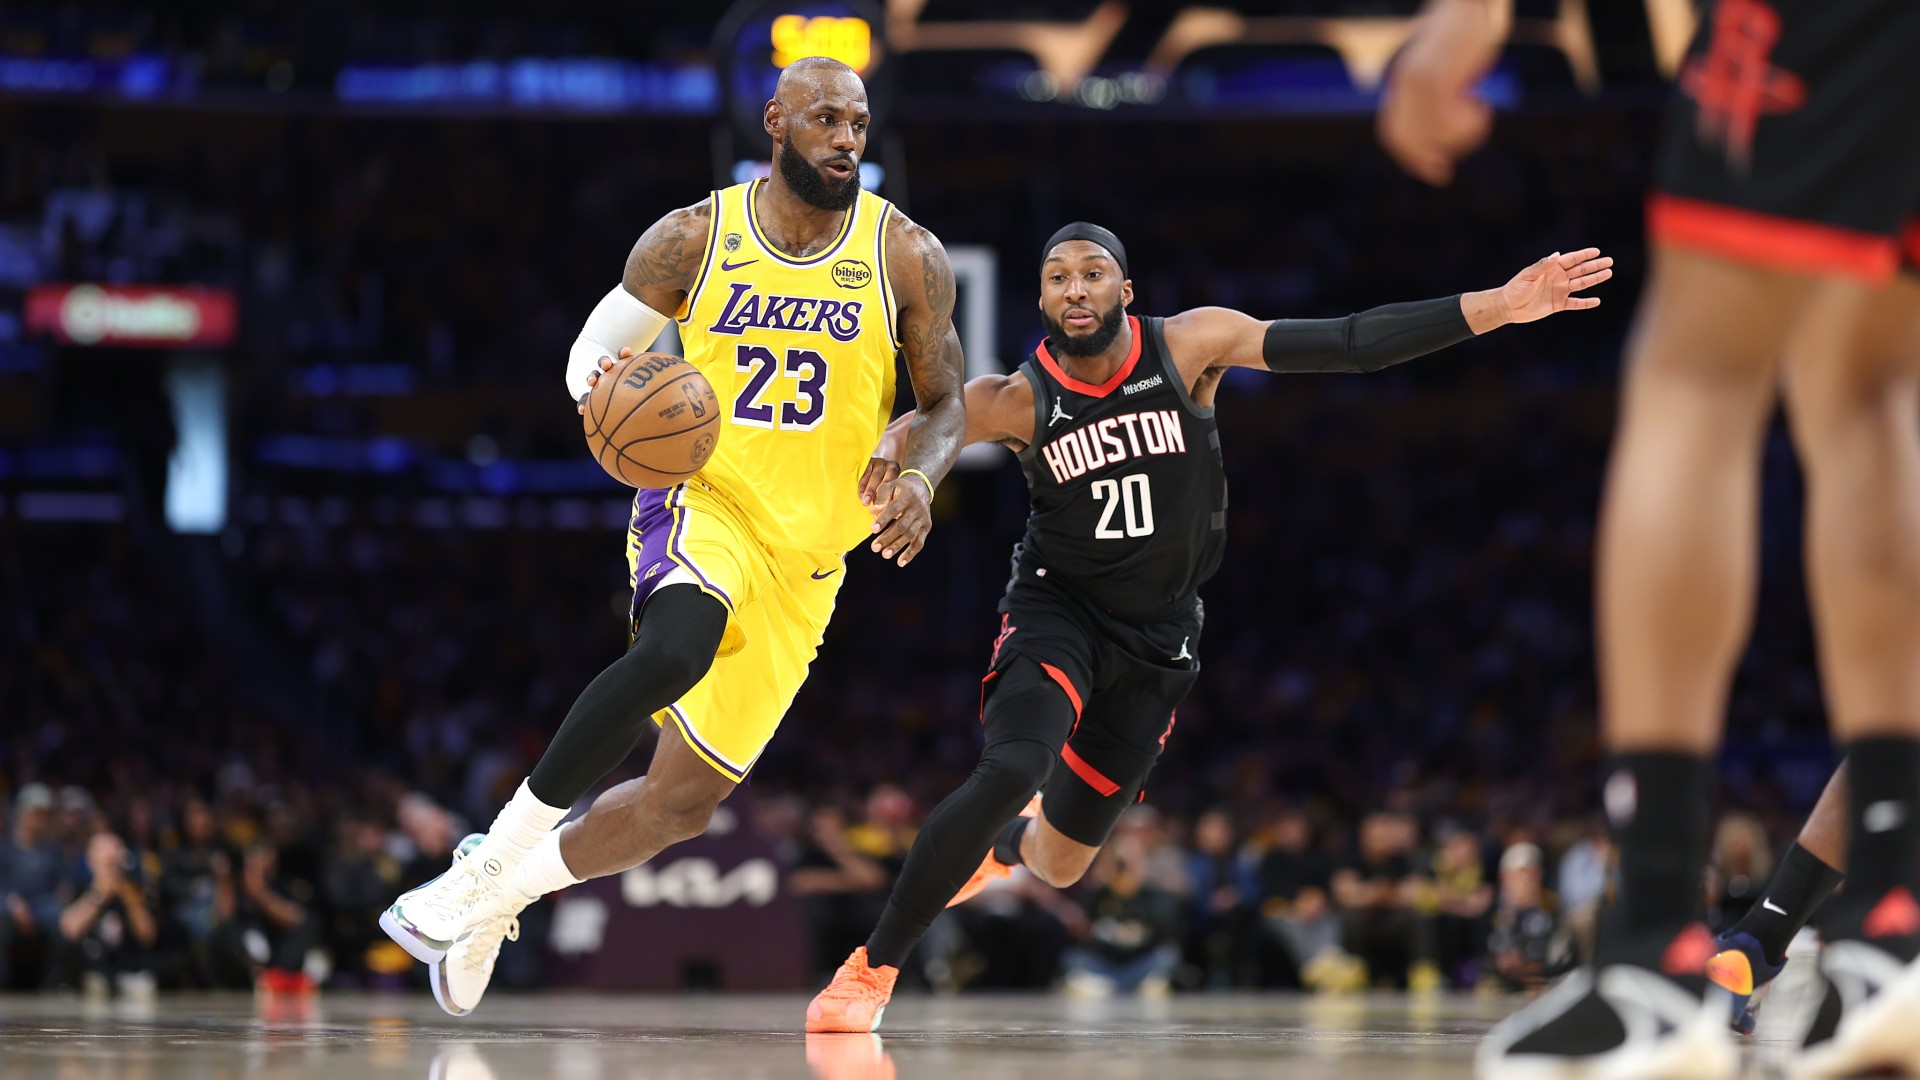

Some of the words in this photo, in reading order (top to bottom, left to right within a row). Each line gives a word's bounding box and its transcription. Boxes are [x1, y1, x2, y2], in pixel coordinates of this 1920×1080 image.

[835, 266, 870, 281] bibigo
[708, 282, 863, 342] LAKERS
[731, 343, 830, 432] 23
[1041, 410, 1187, 484] HOUSTON
[1090, 473, 1155, 540] 20
